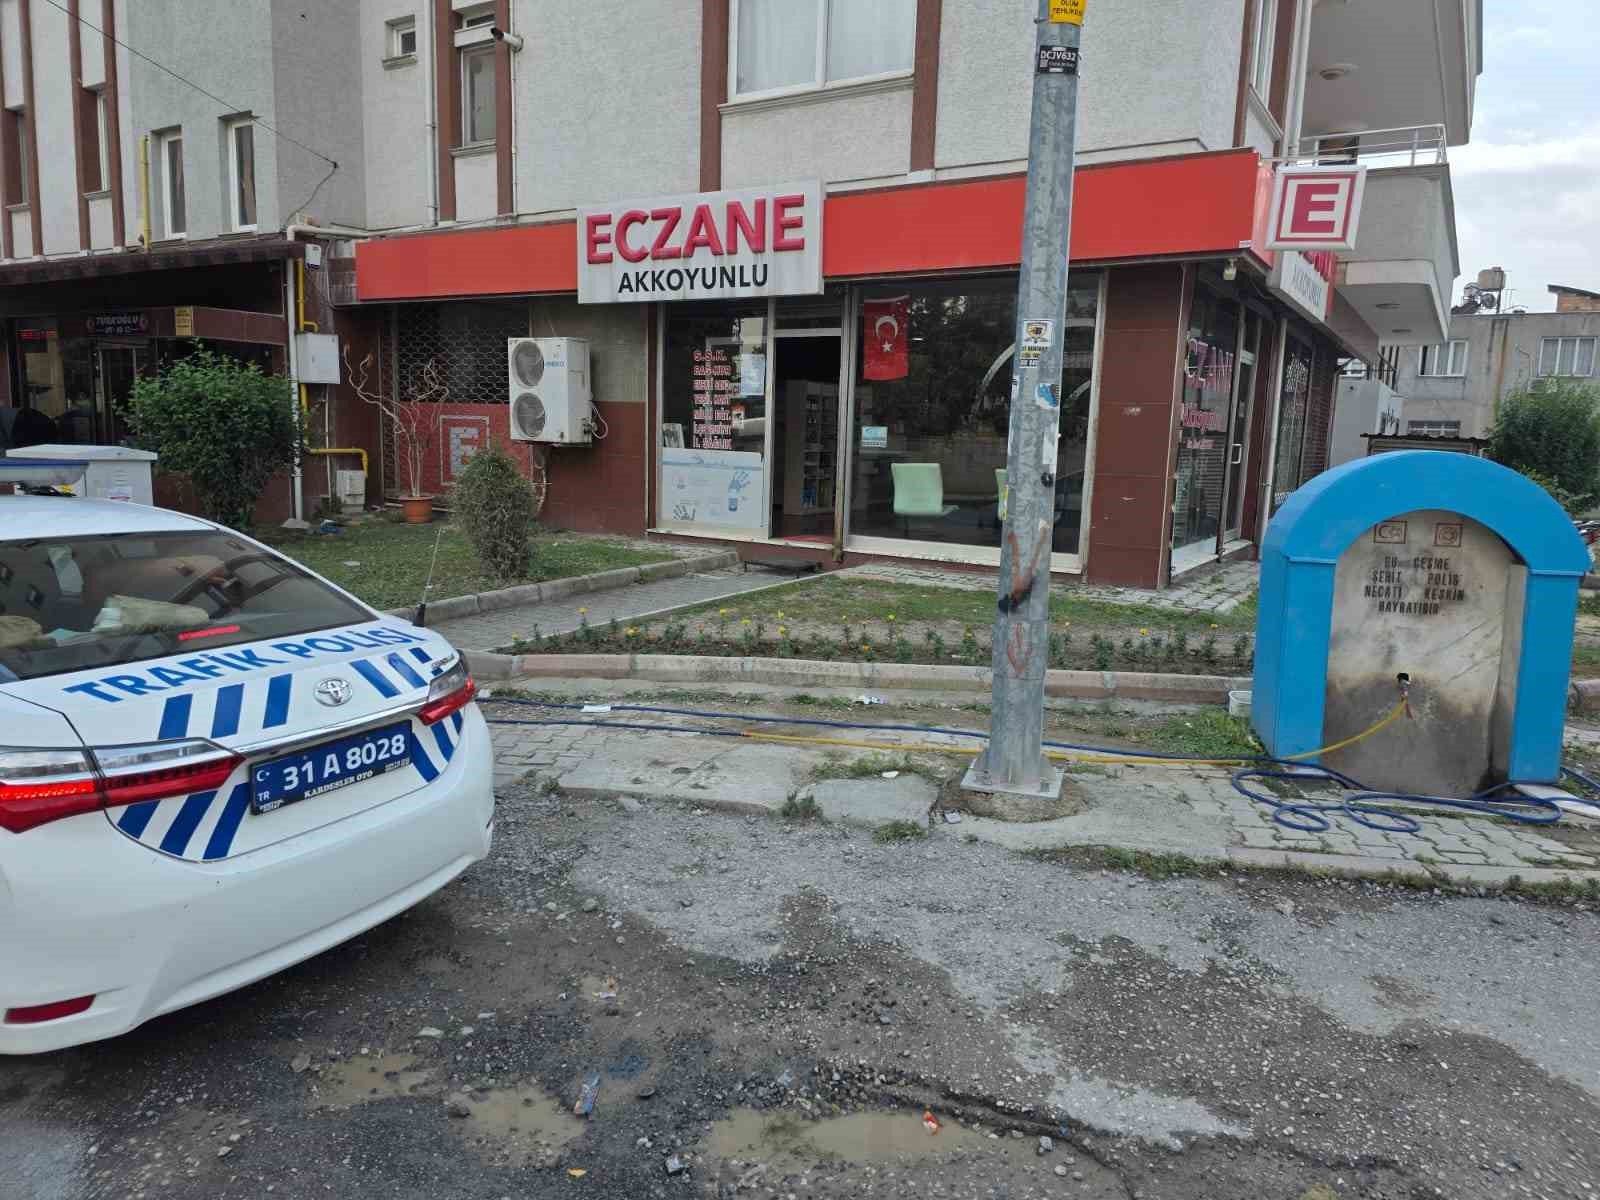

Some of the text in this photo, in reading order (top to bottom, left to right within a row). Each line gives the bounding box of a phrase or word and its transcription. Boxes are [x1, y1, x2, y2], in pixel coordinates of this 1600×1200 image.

[586, 194, 805, 264] ECZANE
[1291, 183, 1339, 233] E
[618, 263, 768, 293] AKKOYUNLU
[64, 648, 283, 703] TRAFİK
[283, 760, 315, 791] 31
[323, 753, 341, 778] A
[346, 734, 406, 770] 8028
[356, 769, 374, 782] OTO
[258, 790, 270, 801] TR
